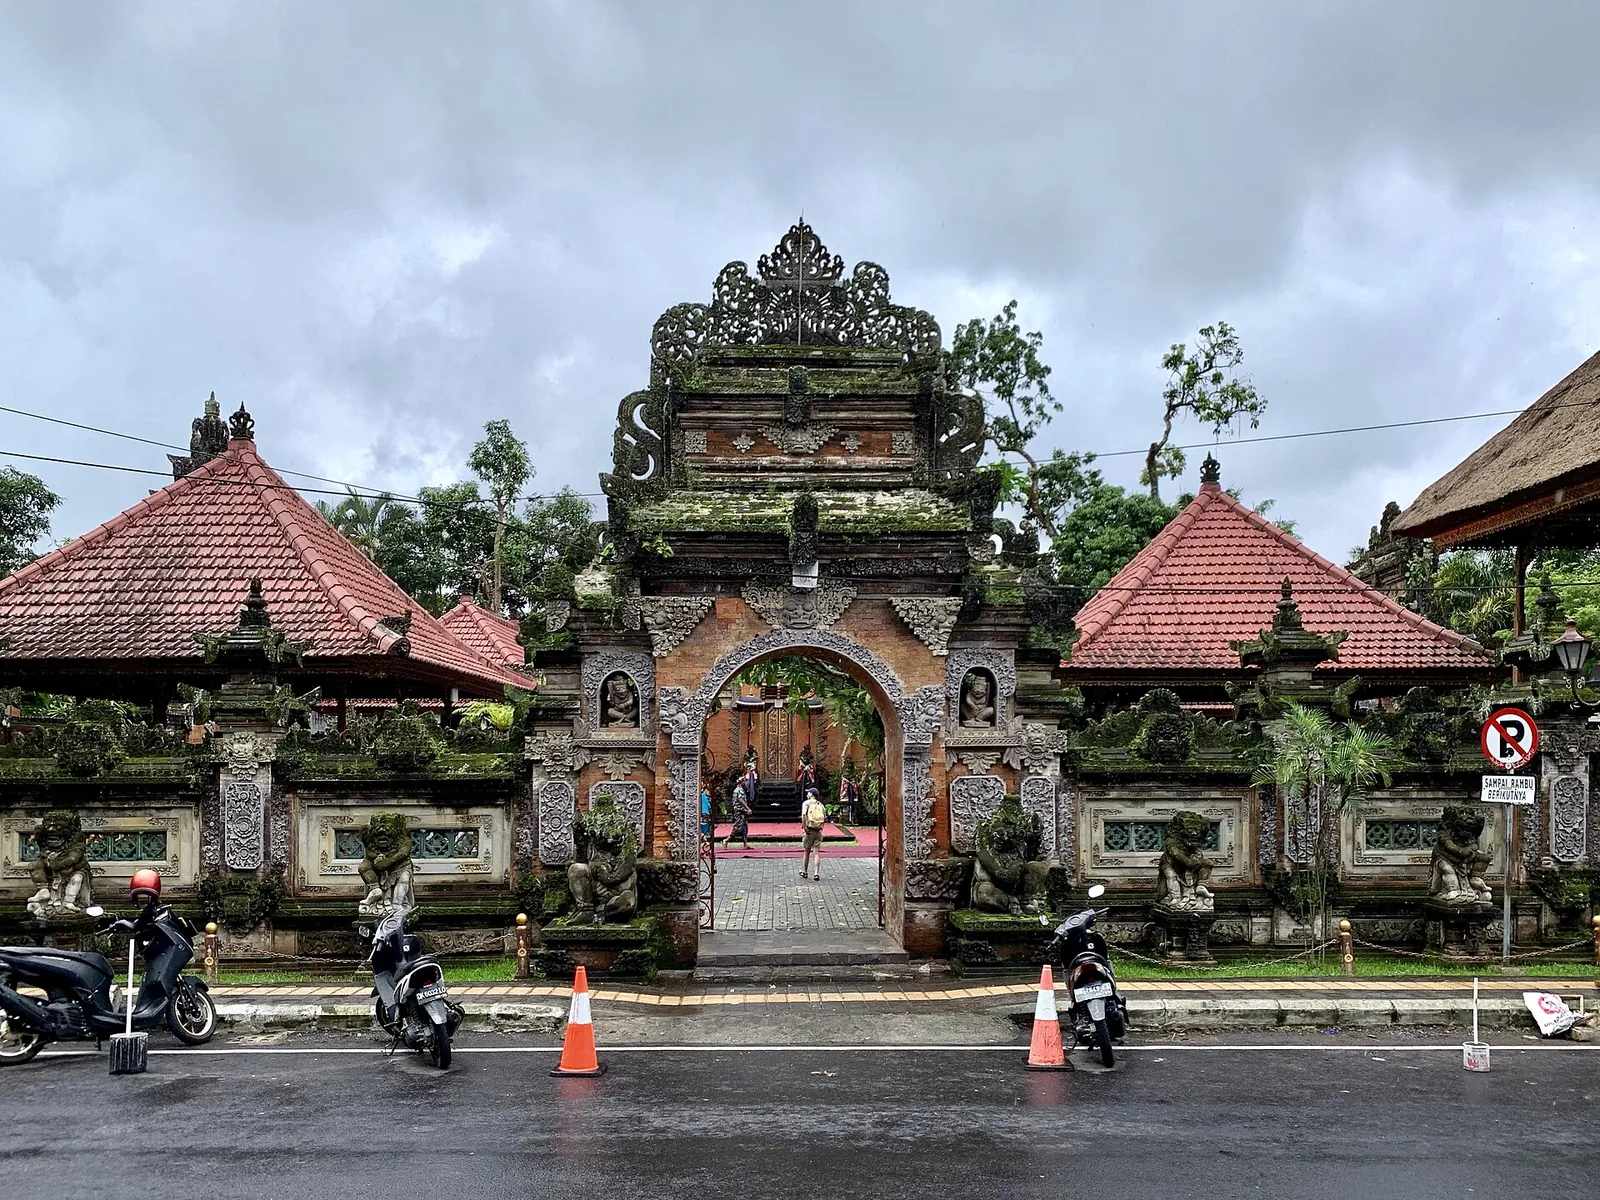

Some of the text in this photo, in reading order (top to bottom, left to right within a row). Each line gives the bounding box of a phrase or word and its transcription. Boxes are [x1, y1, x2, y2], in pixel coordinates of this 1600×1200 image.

[1500, 720, 1525, 758] P
[1485, 778, 1534, 789] SAMPAI RAMBU
[1487, 789, 1527, 801] BERIKUTNYA
